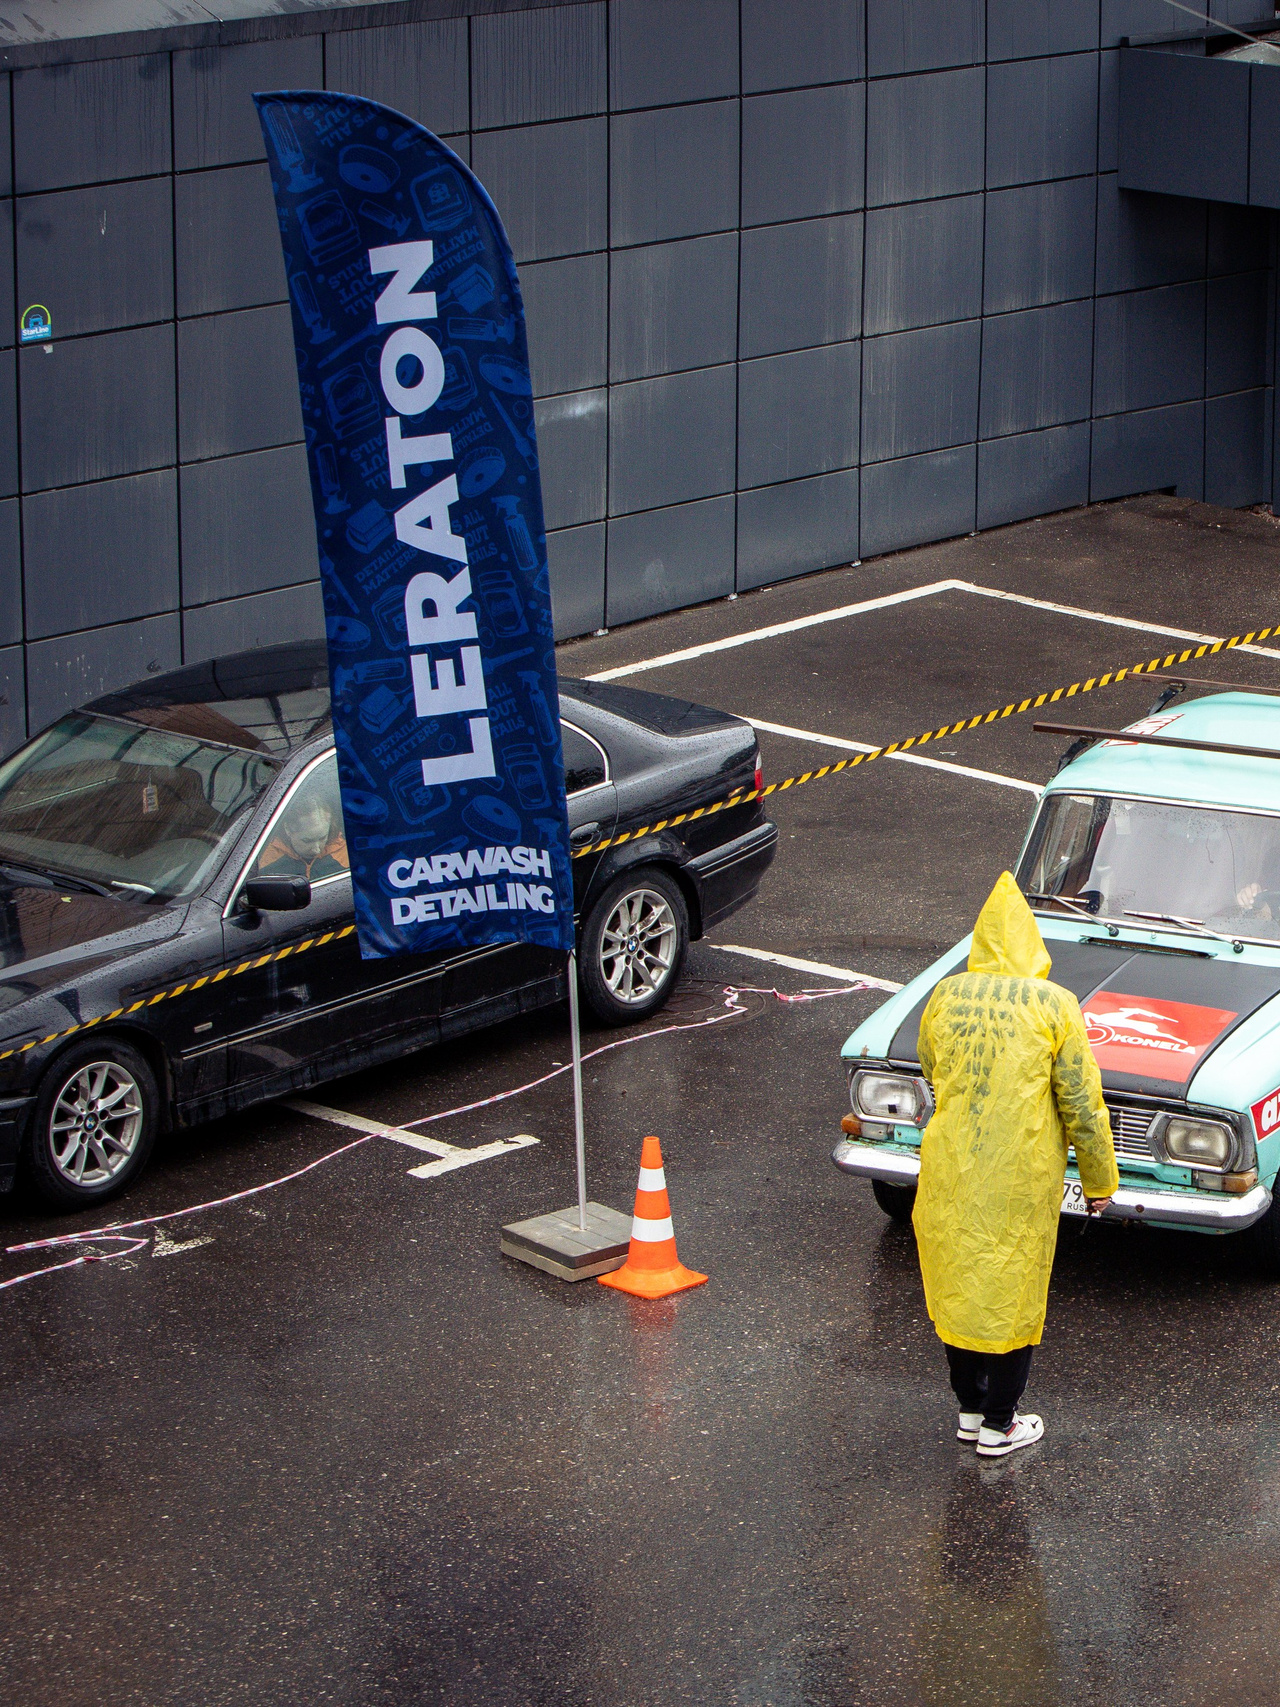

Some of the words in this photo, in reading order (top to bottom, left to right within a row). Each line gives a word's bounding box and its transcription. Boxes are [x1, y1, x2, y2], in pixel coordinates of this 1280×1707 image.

[369, 240, 496, 786] LERATON
[387, 846, 552, 888] CARWASH
[390, 883, 555, 925] DETAILING
[1112, 1033, 1196, 1055] KONELA
[1067, 1202, 1085, 1212] RUS
